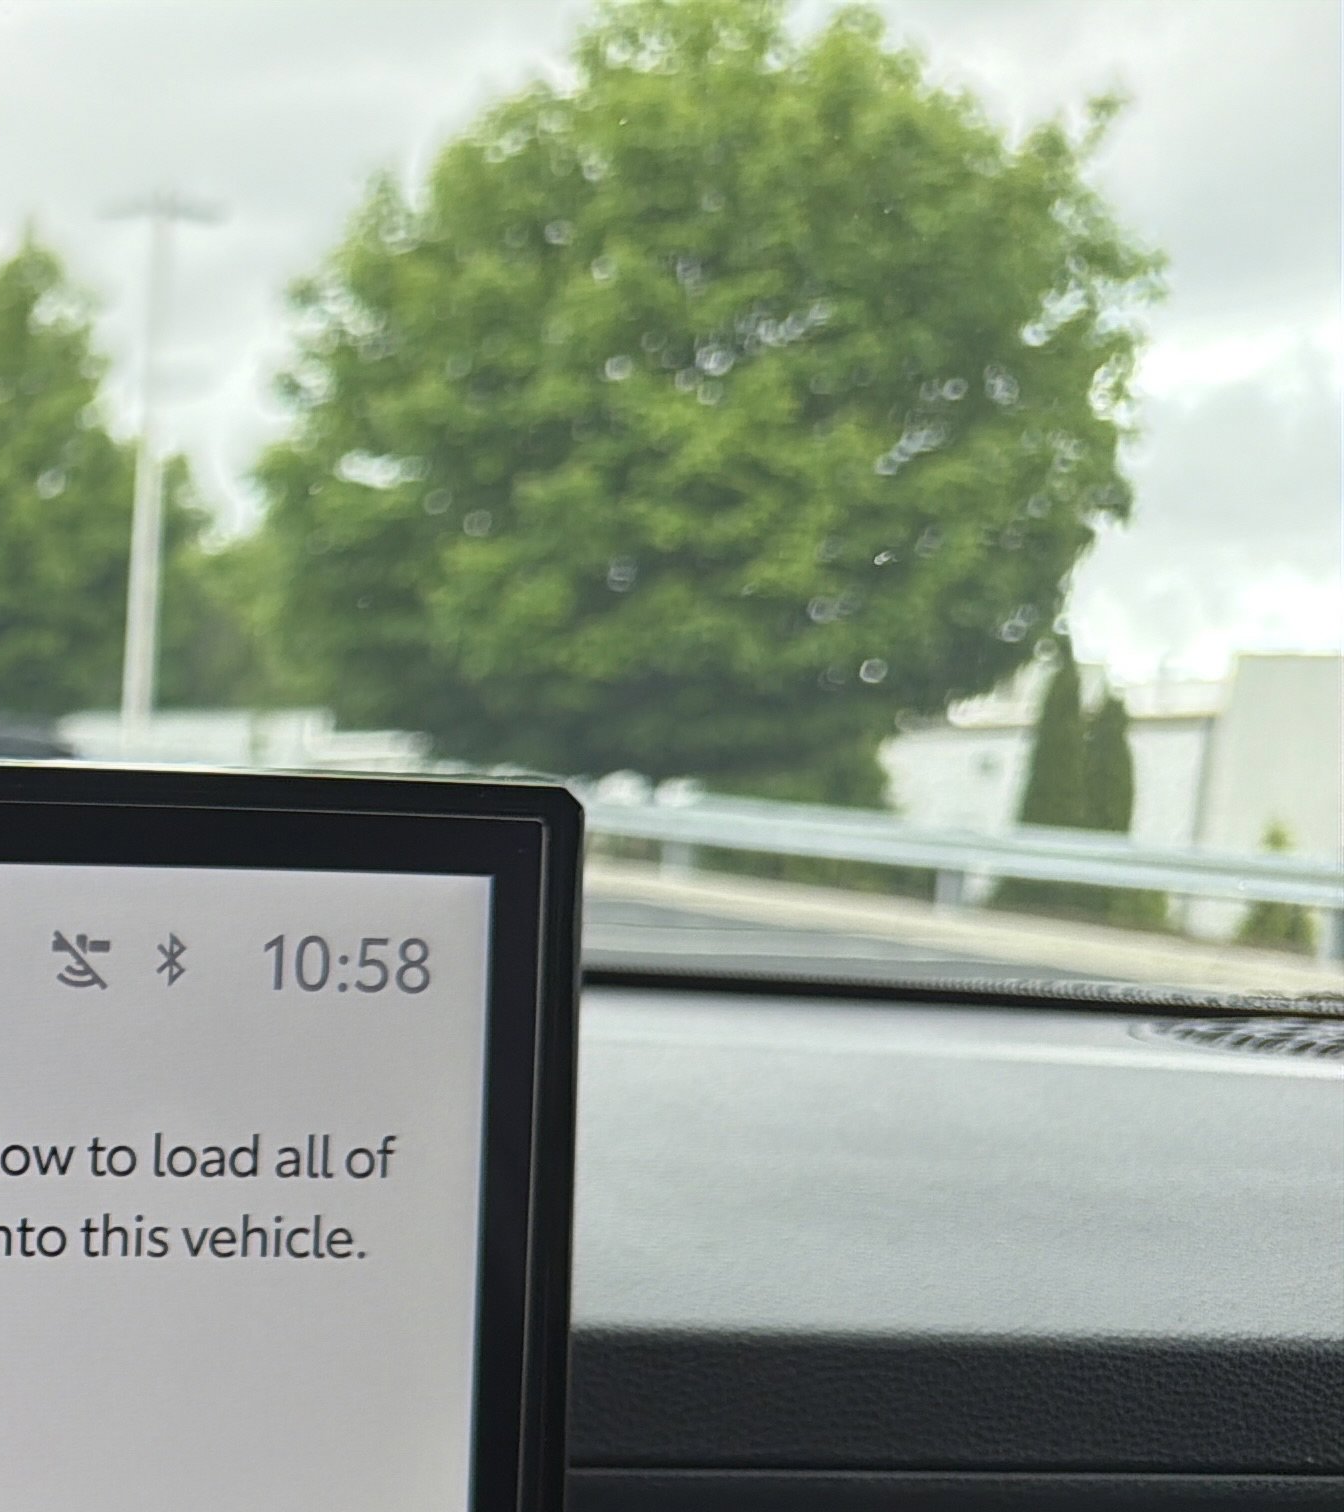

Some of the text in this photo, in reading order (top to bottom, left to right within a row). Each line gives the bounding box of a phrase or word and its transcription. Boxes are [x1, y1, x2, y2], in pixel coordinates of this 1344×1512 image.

[261, 933, 433, 996] 10:58
[88, 1136, 138, 1178] to
[153, 1132, 260, 1178] load
[275, 1133, 334, 1180] all
[345, 1135, 397, 1179] of
[80, 1213, 170, 1259] this
[181, 1213, 368, 1260] vehicle.
